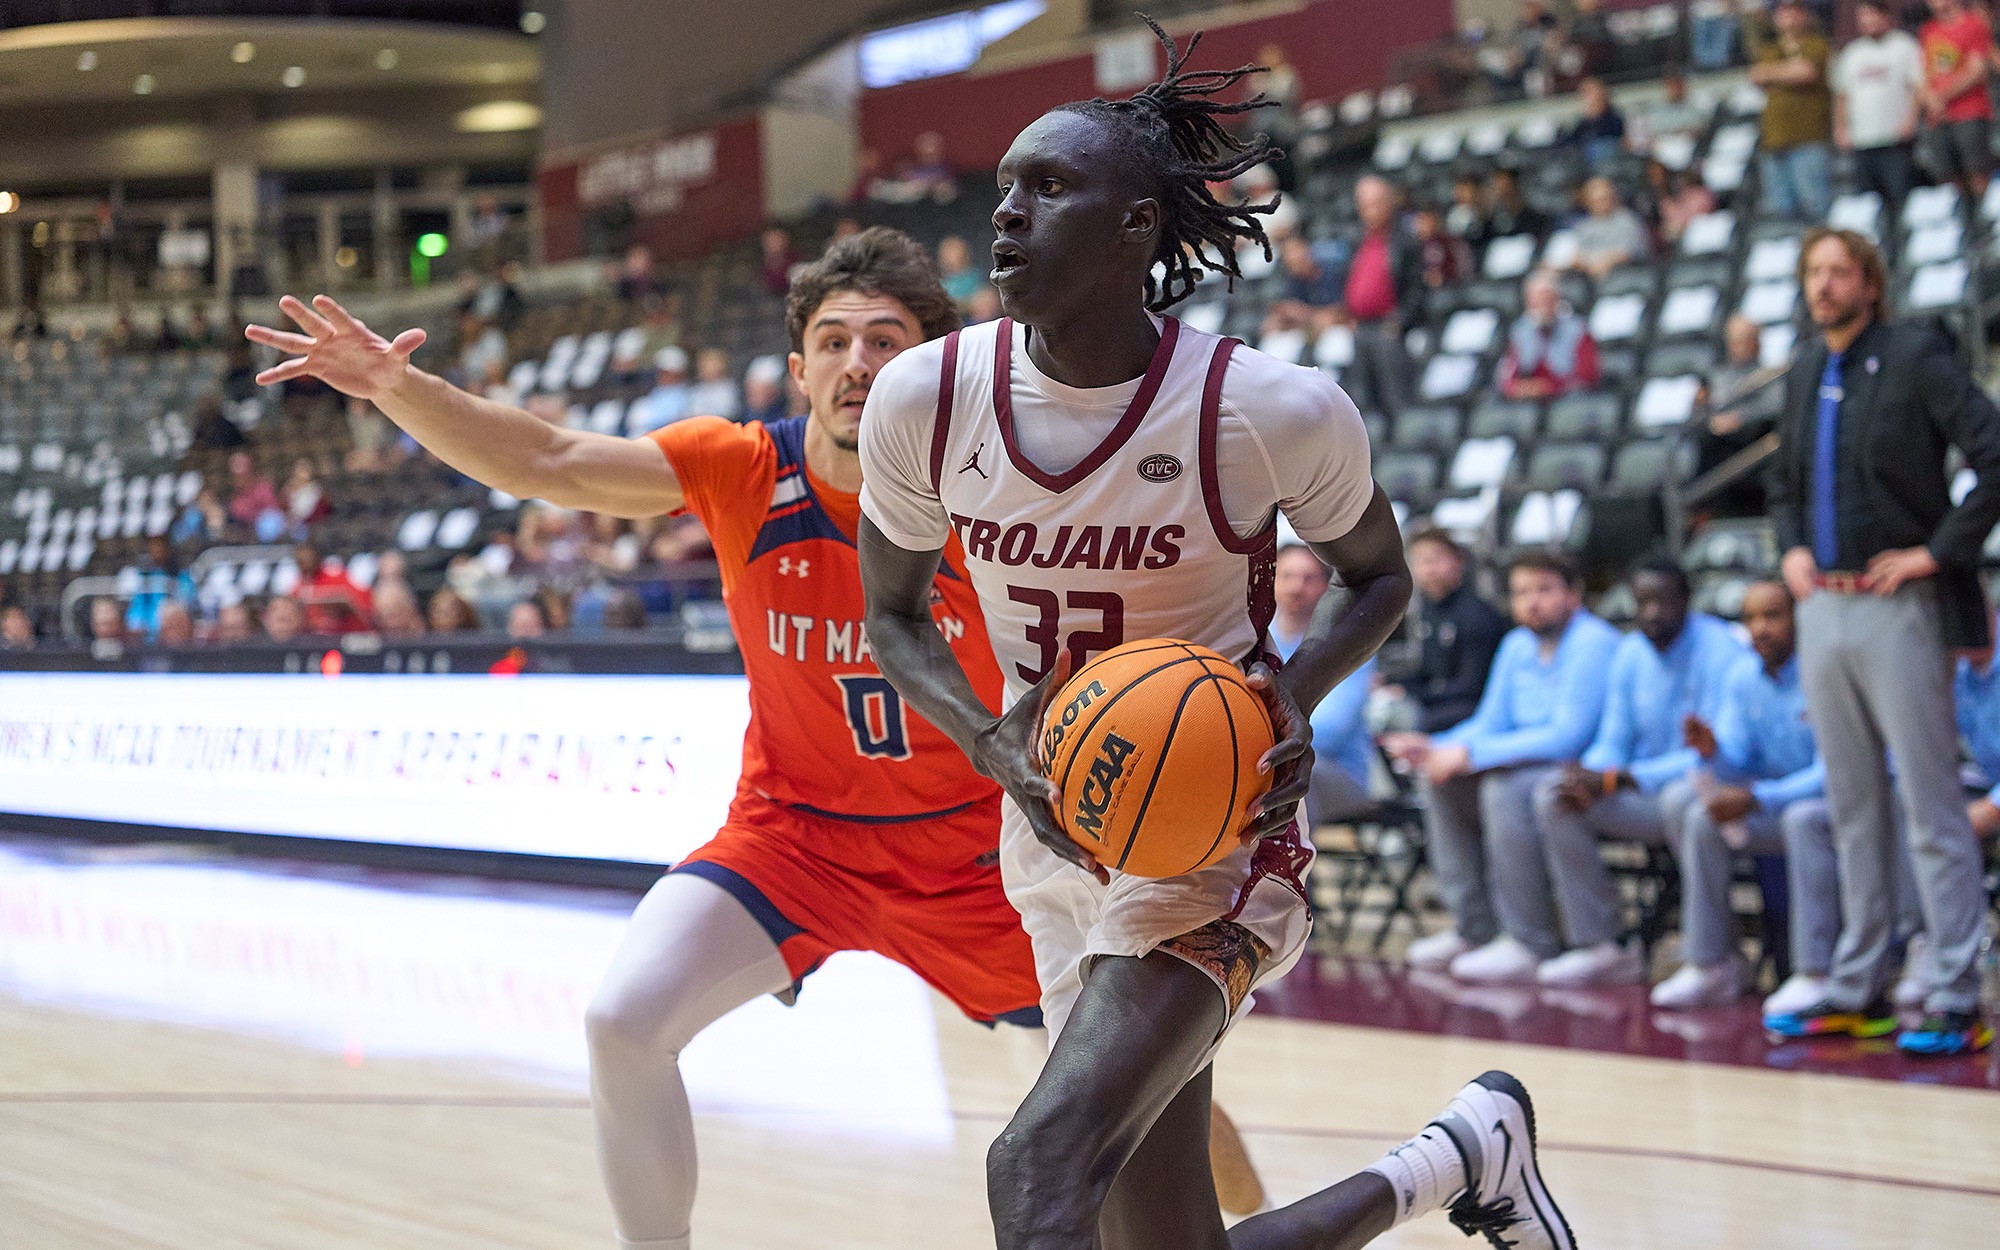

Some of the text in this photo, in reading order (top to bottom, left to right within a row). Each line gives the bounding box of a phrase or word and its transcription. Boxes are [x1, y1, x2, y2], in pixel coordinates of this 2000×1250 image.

[1146, 463, 1173, 475] OVC
[950, 512, 1186, 571] TROJANS
[767, 608, 965, 664] UT MAN
[1006, 584, 1124, 686] 32
[832, 672, 913, 762] 0
[1040, 679, 1108, 777] ilson
[172, 722, 386, 778] TOURNAMENT
[390, 731, 686, 797] APPEARANCES
[1074, 731, 1138, 843] NCAA
